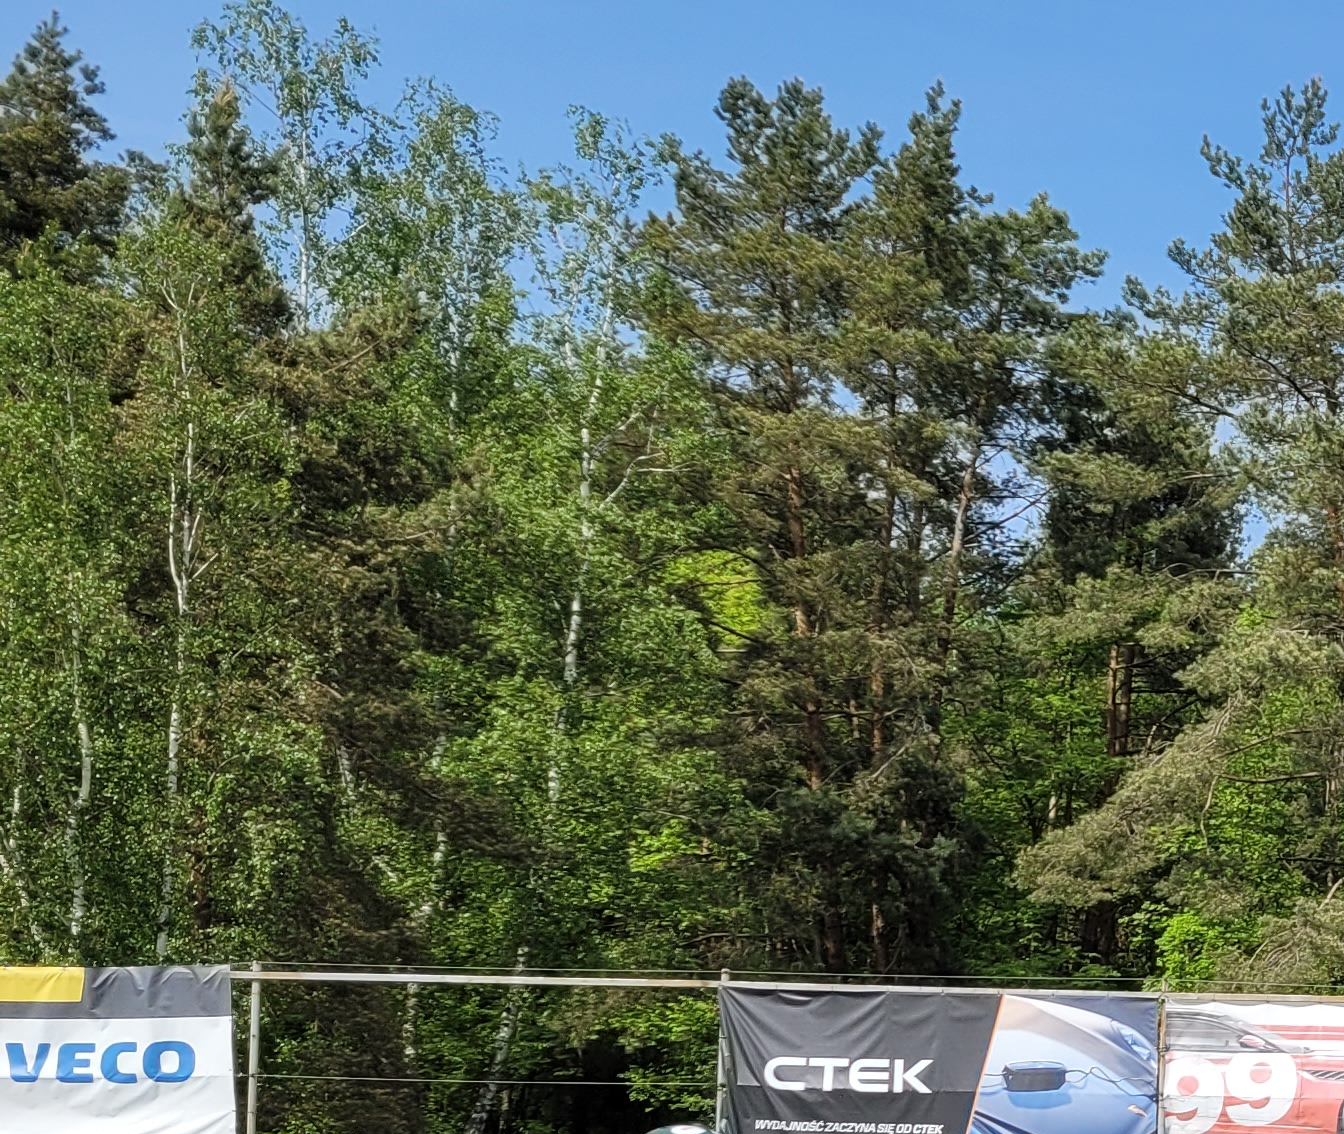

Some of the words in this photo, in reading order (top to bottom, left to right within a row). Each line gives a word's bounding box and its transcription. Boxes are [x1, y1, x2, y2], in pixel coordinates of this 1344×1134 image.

[763, 1056, 934, 1095] CTEK
[754, 1119, 824, 1132] WYDAJNOŚĆ
[824, 1121, 876, 1133] ZACZYNA
[896, 1123, 912, 1134] OD
[912, 1123, 944, 1134] CTEK
